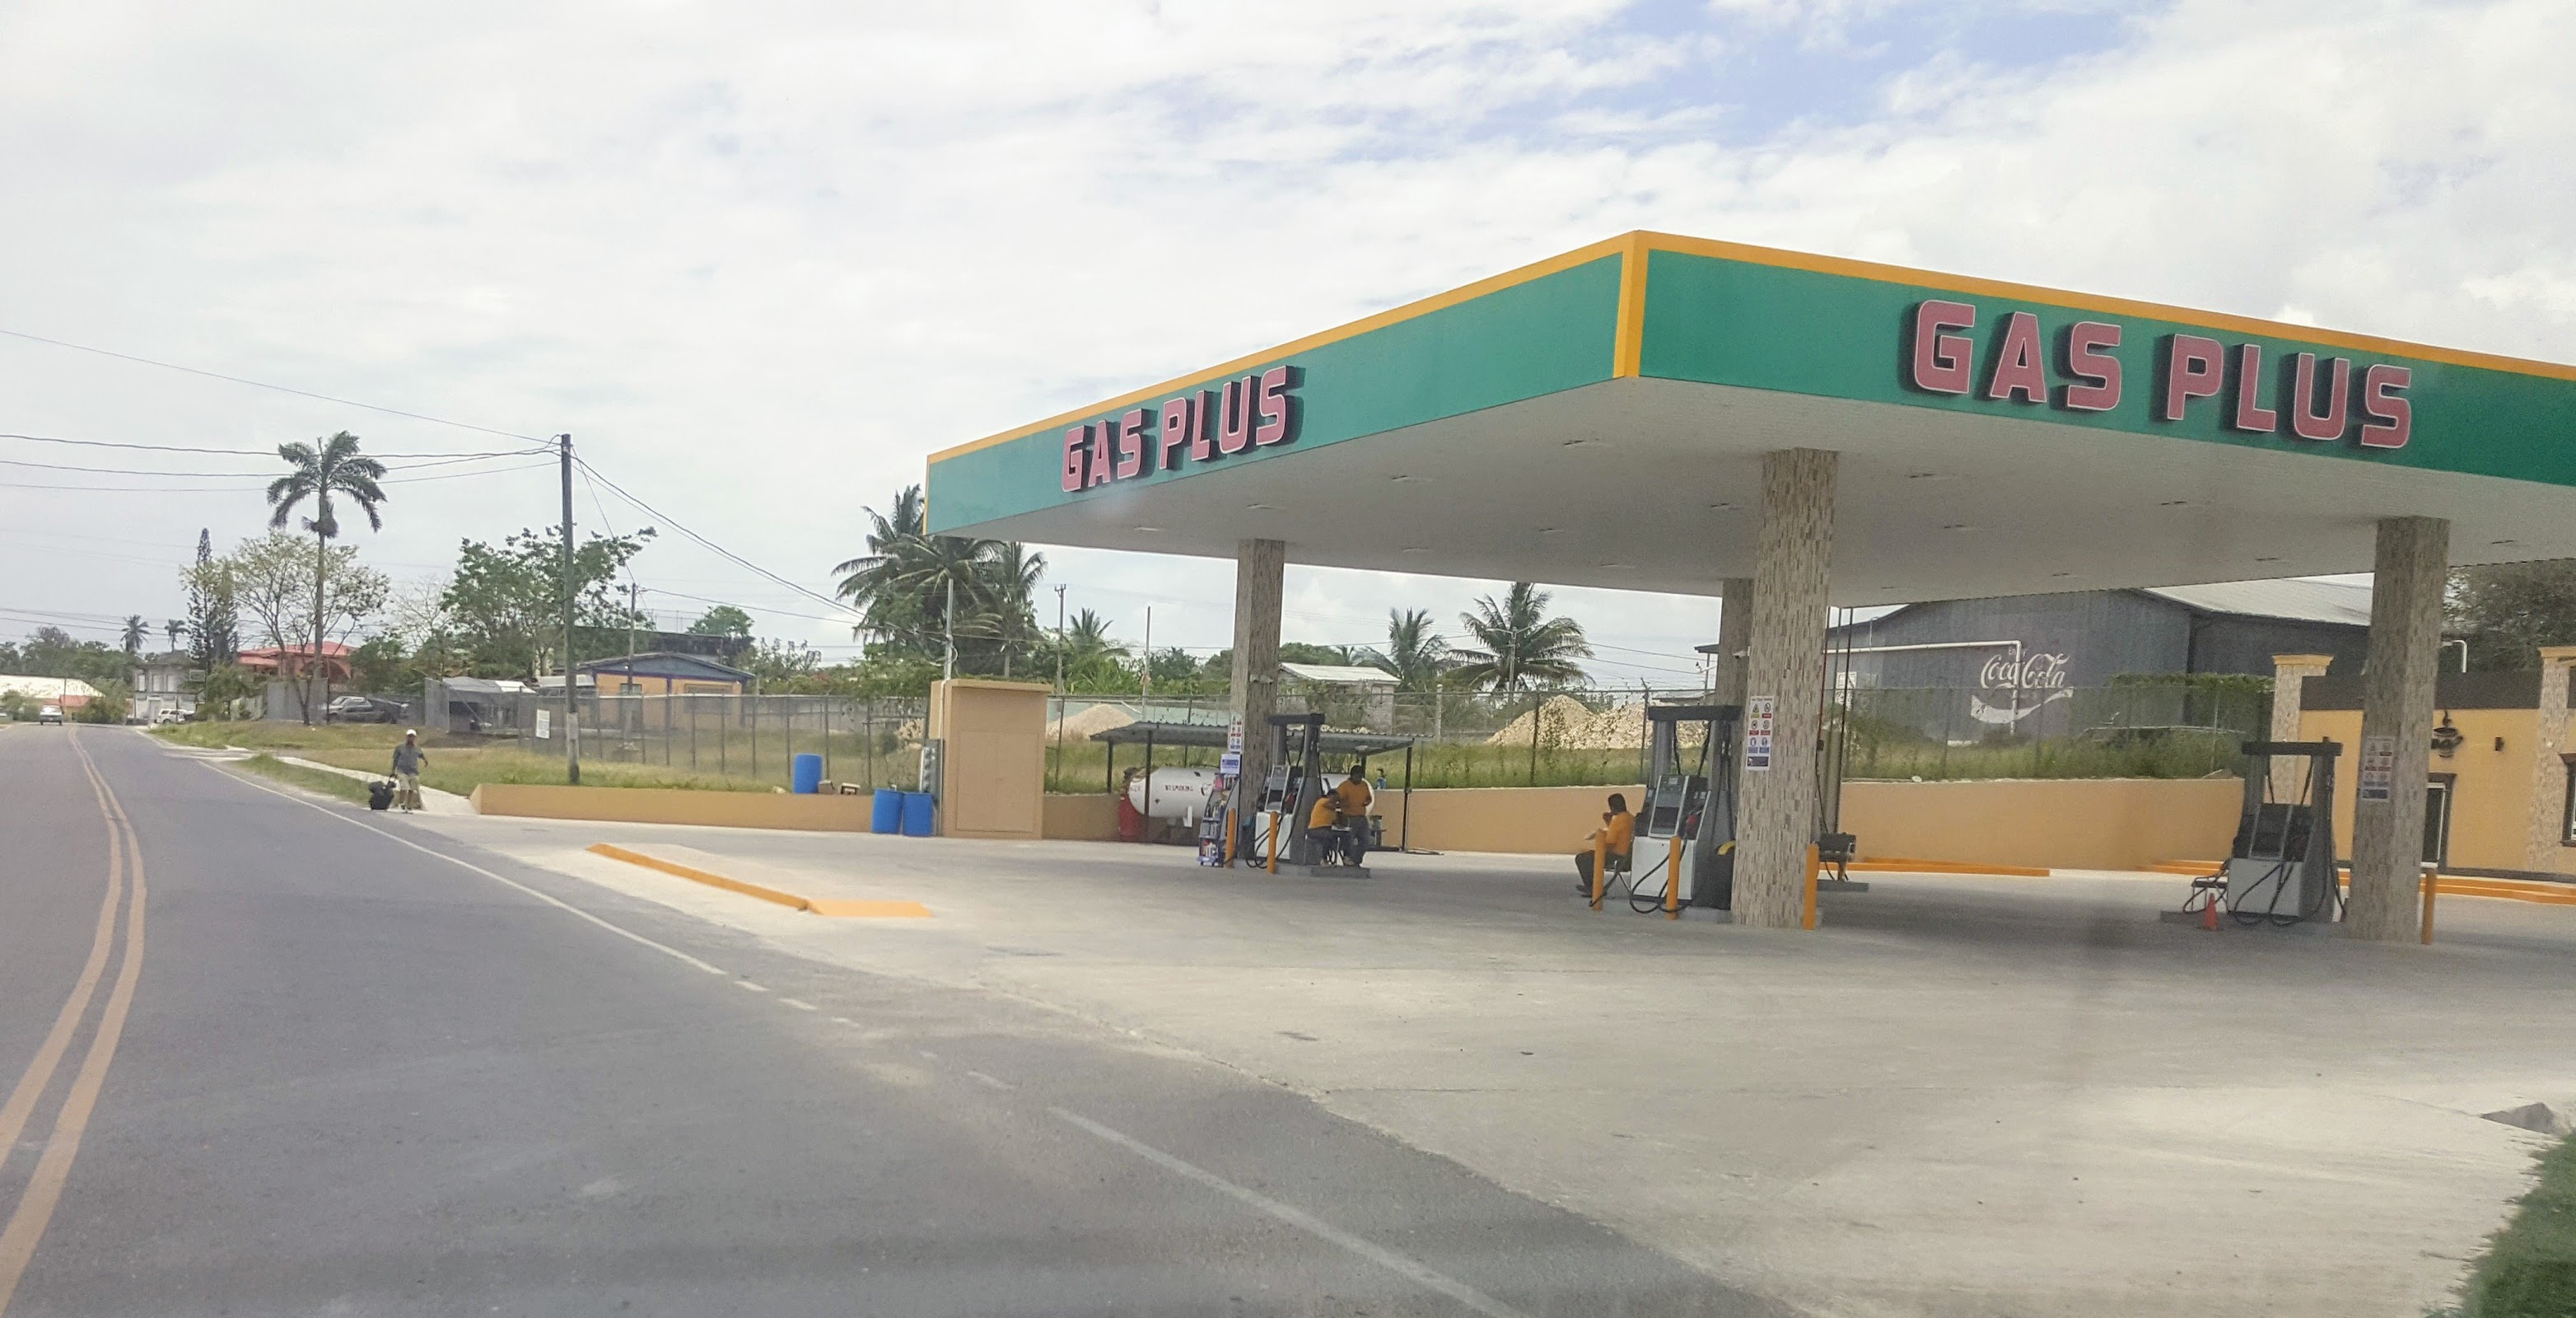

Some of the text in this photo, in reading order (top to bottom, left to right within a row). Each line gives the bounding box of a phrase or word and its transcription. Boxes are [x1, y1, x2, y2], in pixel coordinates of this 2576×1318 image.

[1062, 365, 1287, 493] GAS PLUS
[1914, 299, 2413, 449] GAS PLUS
